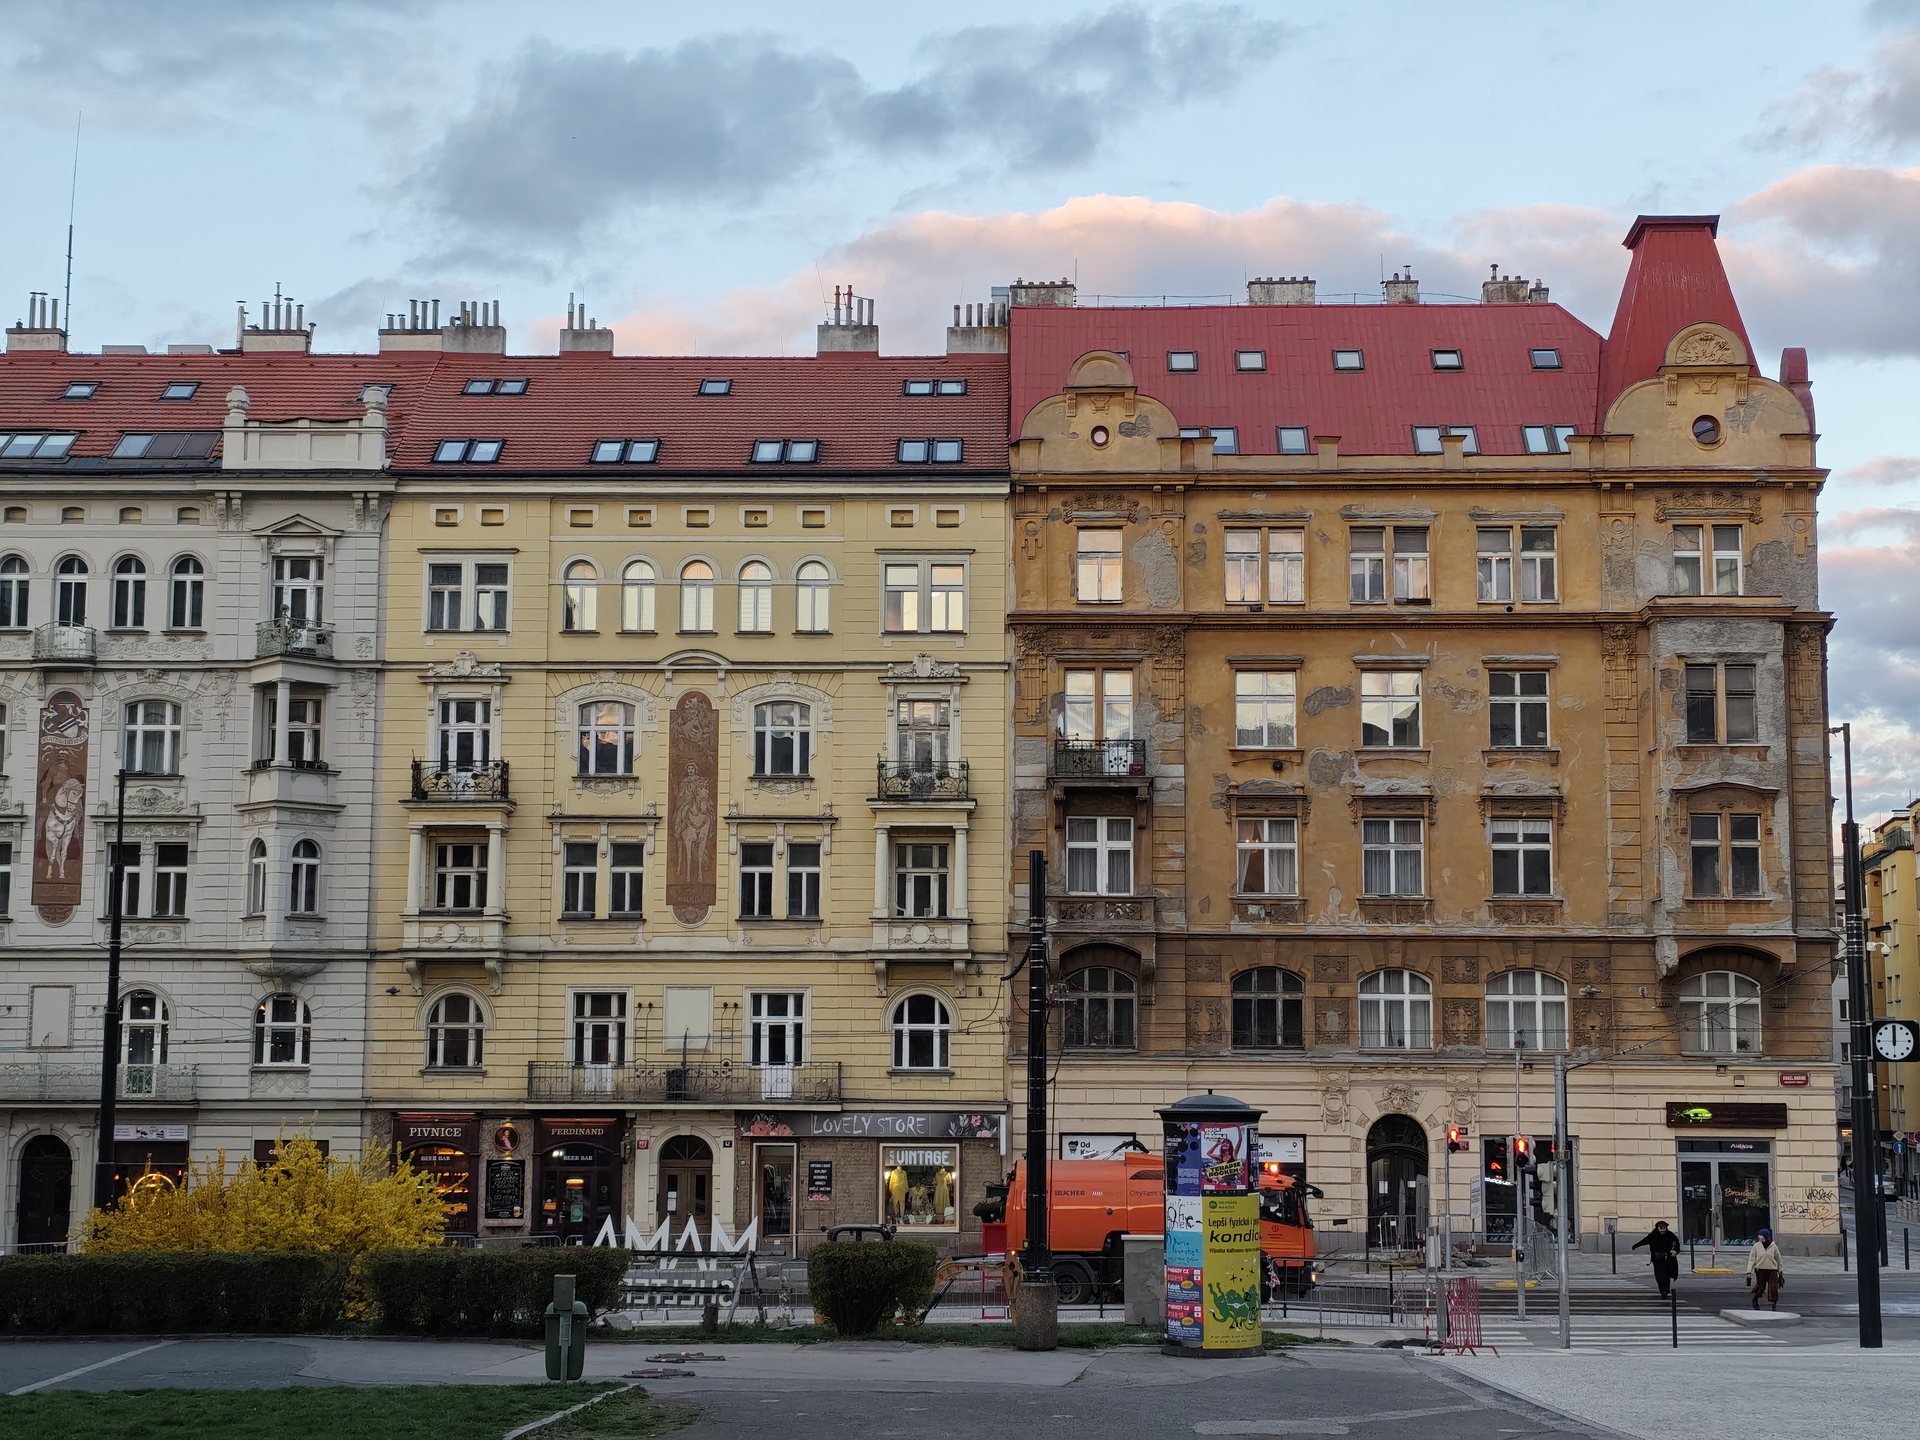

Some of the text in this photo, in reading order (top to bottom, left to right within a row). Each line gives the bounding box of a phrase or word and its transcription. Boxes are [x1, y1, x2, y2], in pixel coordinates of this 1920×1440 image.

[812, 1114, 927, 1135] LOVELY STORE
[409, 1127, 462, 1137] PIVNICE
[551, 1128, 604, 1136] FERDINAND
[896, 1150, 950, 1166] VINTAGE
[1208, 1167, 1239, 1178] ROCKEM
[1208, 1217, 1227, 1229] Lepší
